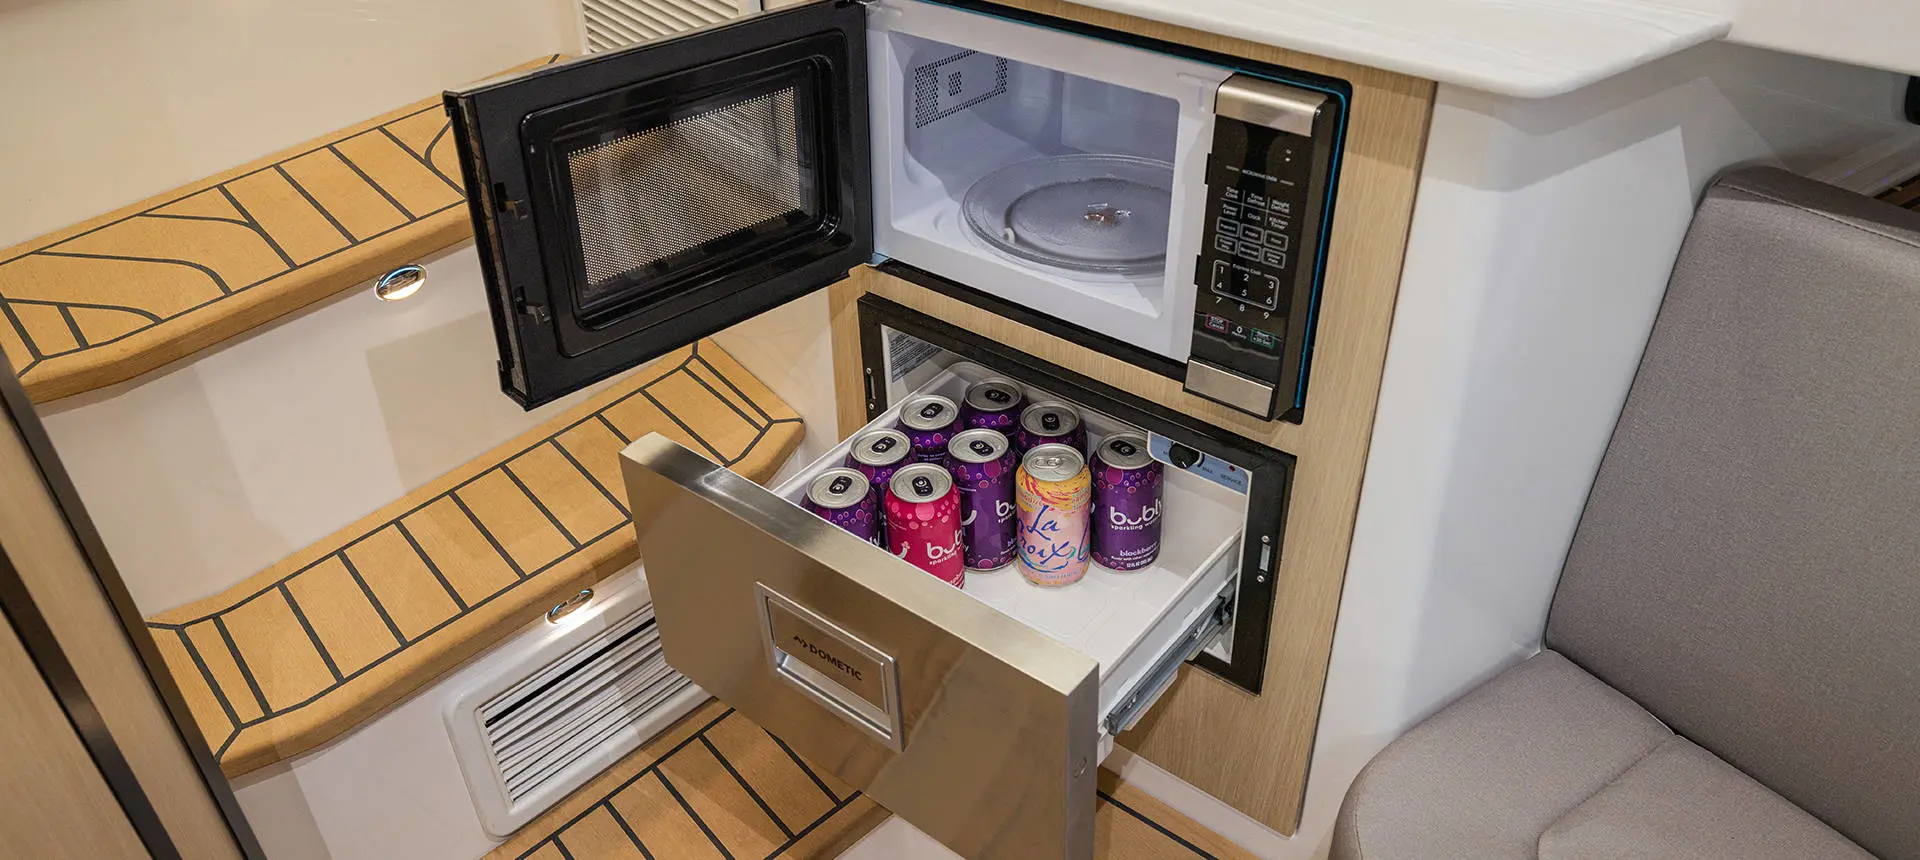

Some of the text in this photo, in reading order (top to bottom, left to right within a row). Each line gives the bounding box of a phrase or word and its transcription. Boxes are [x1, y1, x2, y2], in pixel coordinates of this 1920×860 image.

[1226, 186, 1239, 194] Time
[1250, 193, 1263, 201] Time
[1220, 266, 1275, 289] 1 2 3
[1241, 289, 1247, 297] 5
[1239, 304, 1245, 312] 8
[1263, 311, 1269, 319] 9
[1236, 326, 1243, 334] 0
[1026, 504, 1061, 541] La
[809, 642, 863, 681] DOMETIC
